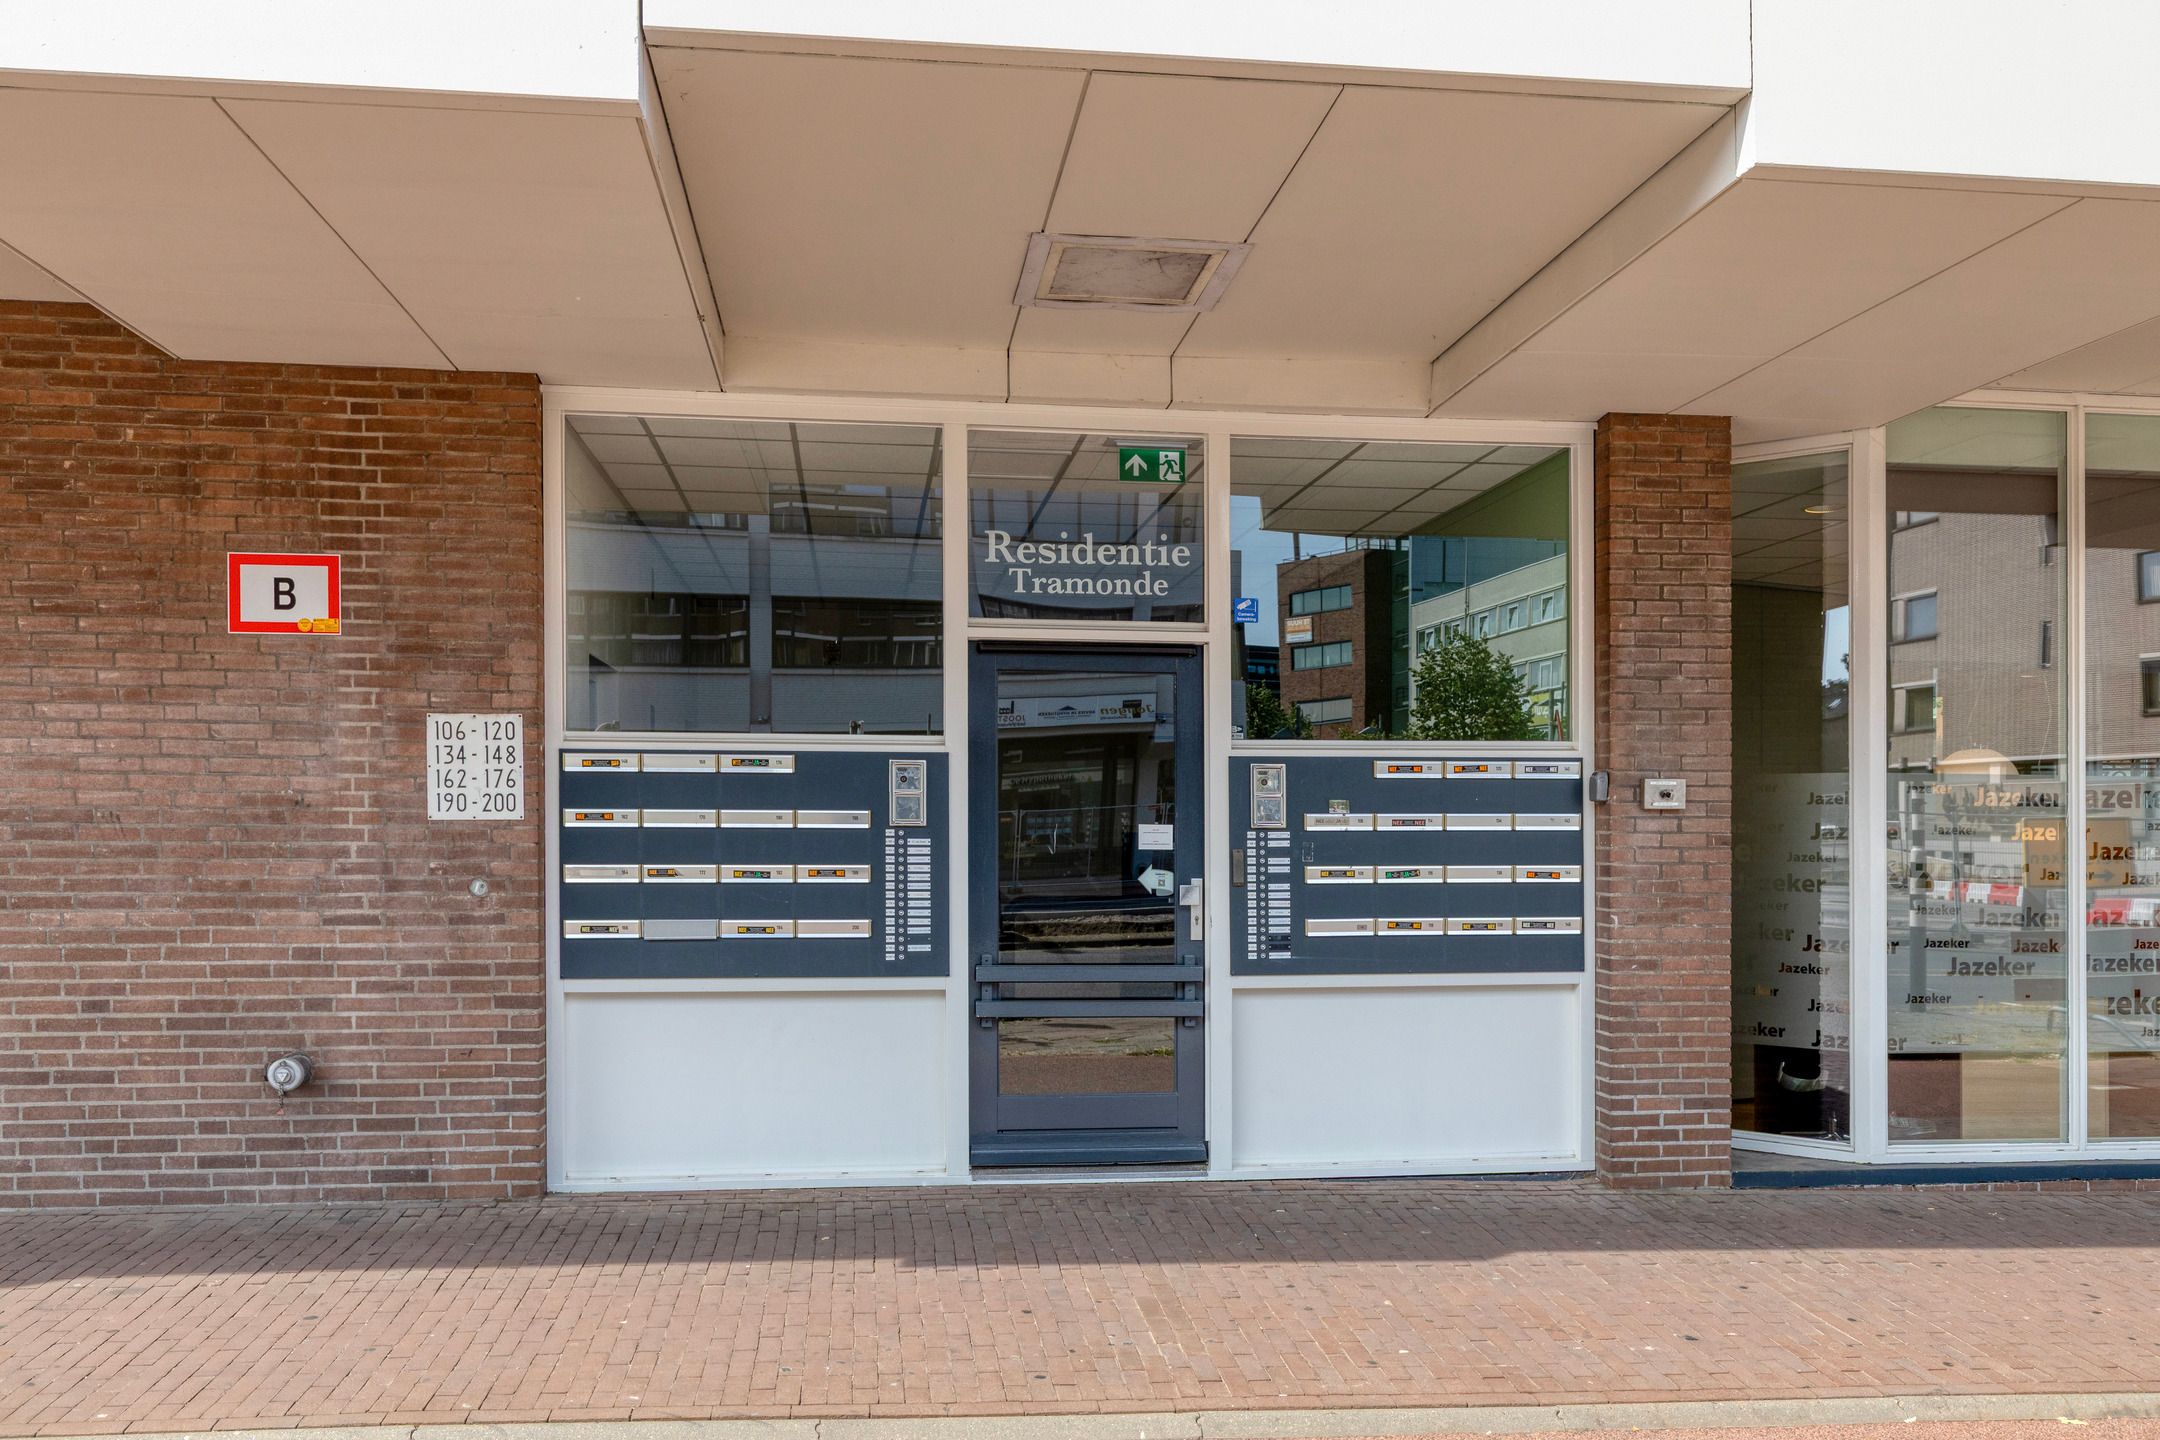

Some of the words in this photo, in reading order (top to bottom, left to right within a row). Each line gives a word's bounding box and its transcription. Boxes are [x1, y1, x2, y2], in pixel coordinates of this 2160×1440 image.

[984, 530, 1191, 567] Residentie
[1009, 568, 1169, 596] Tramonde
[273, 577, 297, 610] B
[434, 721, 466, 741] 106
[483, 721, 515, 741] 120
[435, 745, 466, 765] 134
[484, 745, 516, 764] 148
[435, 769, 466, 788] 162
[485, 769, 516, 788] 176
[436, 793, 467, 812] 190
[482, 793, 516, 812] 200
[2010, 822, 2060, 841] Jaze
[1786, 851, 1838, 863] Jazeker
[1914, 904, 1961, 916] Jazeker
[1923, 938, 1971, 949] Jazeker
[1778, 962, 1831, 976] Jazeker
[1946, 956, 2036, 977] Jazeker
[1904, 992, 1952, 1005] Jazeker
